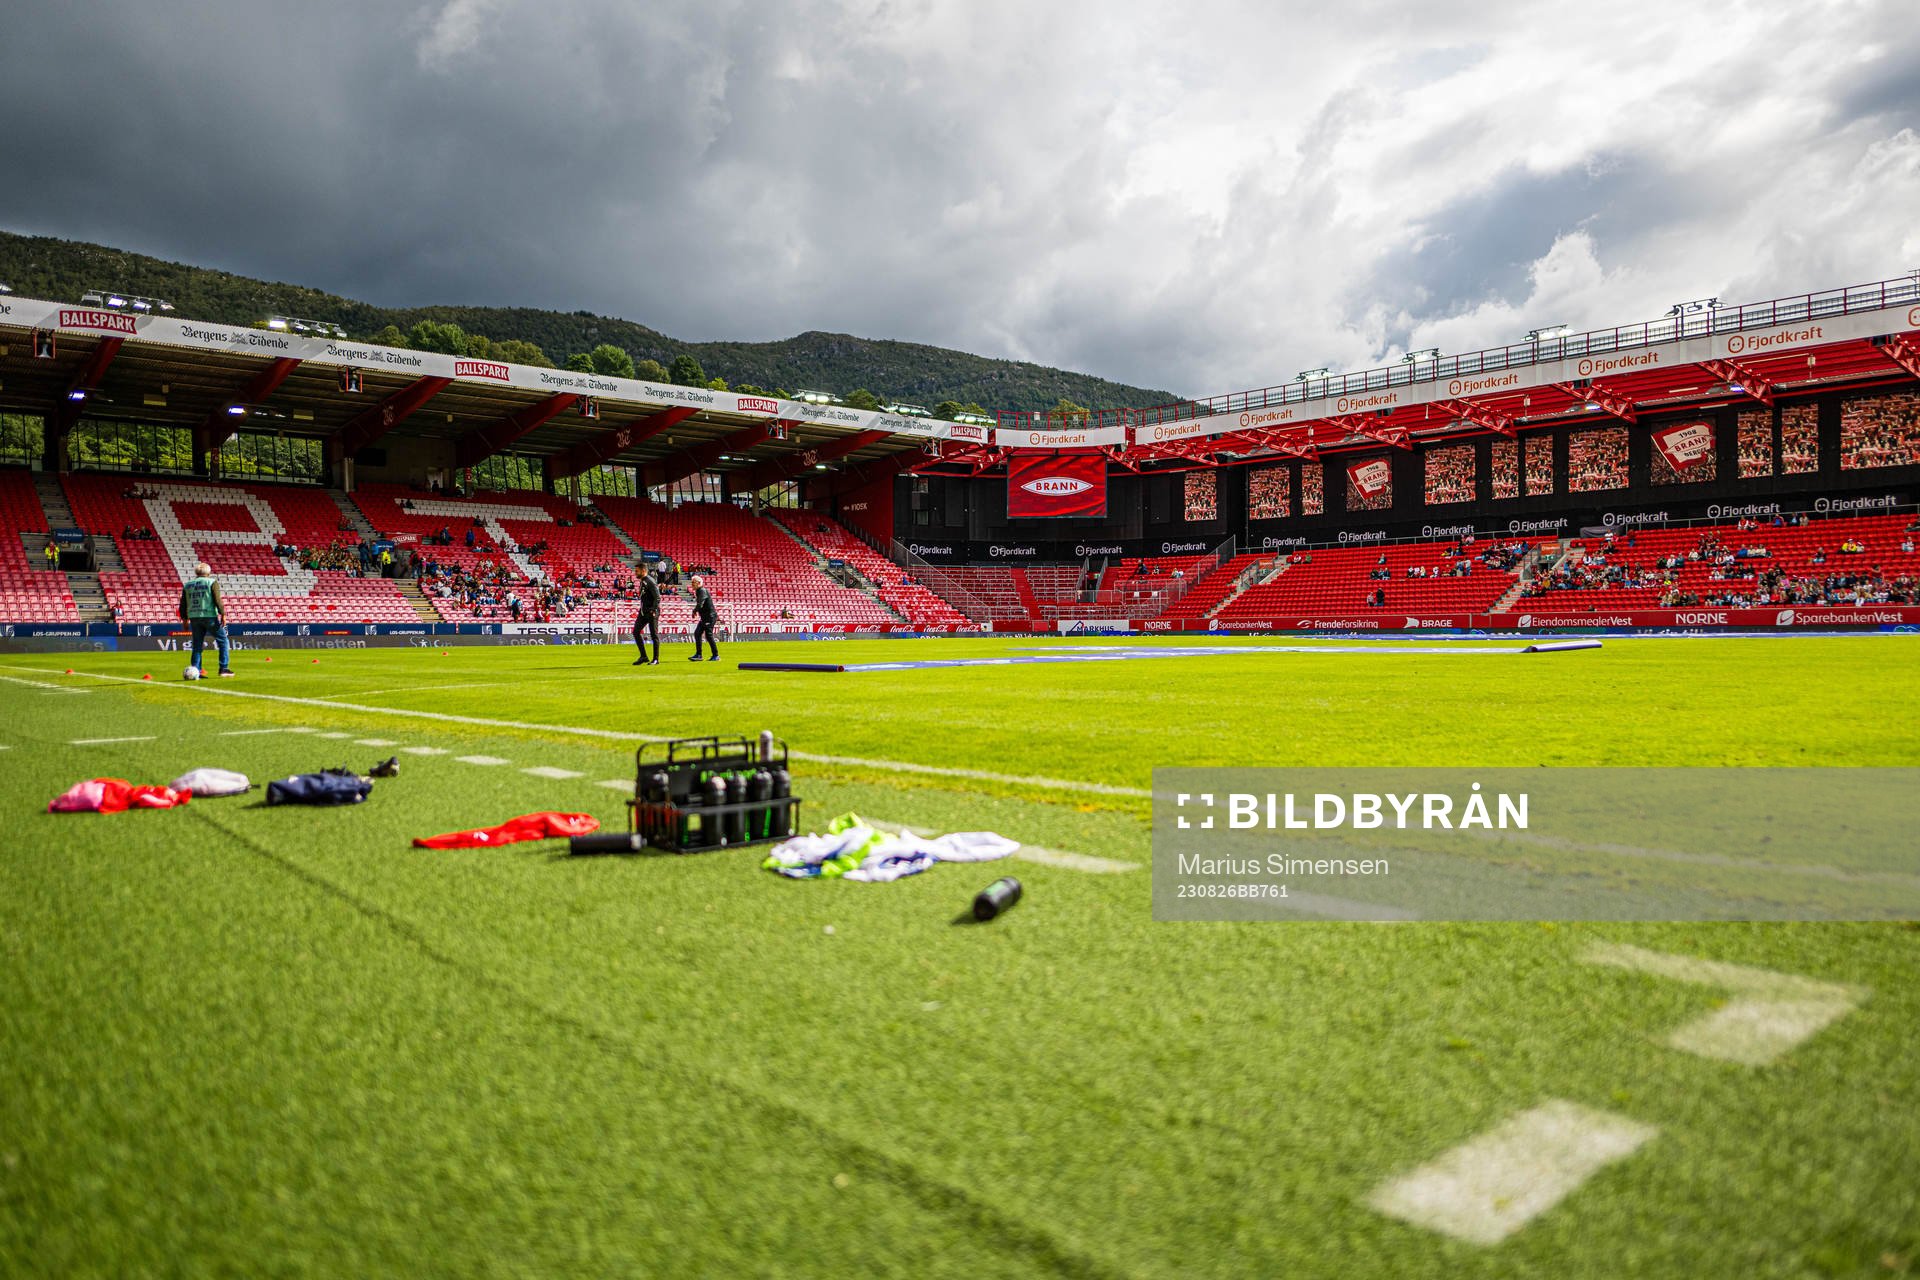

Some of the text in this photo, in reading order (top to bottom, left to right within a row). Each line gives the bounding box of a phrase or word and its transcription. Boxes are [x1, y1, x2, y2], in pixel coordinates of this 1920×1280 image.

[61, 311, 133, 333] BALLSPARK
[180, 325, 289, 350] Bergens Tidende
[1748, 326, 1822, 349] Fjordkraft
[326, 344, 422, 367] Bergens Tidende
[1596, 352, 1658, 373] Fjordkraft
[456, 362, 508, 380] BALLSPARK
[540, 373, 618, 392] Bergens Tidende
[1464, 374, 1518, 393] Fjordkraft
[644, 386, 714, 404] Bergens Tidende
[1350, 393, 1397, 409] Fjordkraft
[739, 399, 777, 414] BALLSPARK
[1251, 408, 1293, 423] Fjordkraft
[952, 427, 981, 439] BALLSPARK
[1164, 422, 1201, 437] Fjordkraft
[1679, 429, 1697, 438] 1908
[1042, 434, 1086, 445] Fjordkraft
[1036, 481, 1078, 491] BRANN
[1832, 496, 1896, 510] Fjordkraft
[1722, 503, 1780, 517] Fjordkraft
[1616, 511, 1668, 524] Fjordkraft
[1433, 524, 1474, 536] Fjordkraft
[1521, 518, 1568, 531] Fjordkraft
[1272, 536, 1306, 548] Fjordkraft
[1348, 530, 1386, 542] Fjordkraft
[919, 545, 952, 556] Fjordkraft
[998, 546, 1036, 556] Fjordkraft
[1085, 545, 1122, 556] Fjordkraft
[1170, 542, 1206, 552] Fjordkraft
[1676, 613, 1728, 624] NORNE
[1144, 622, 1172, 630] NORNE
[157, 638, 177, 651] Vi
